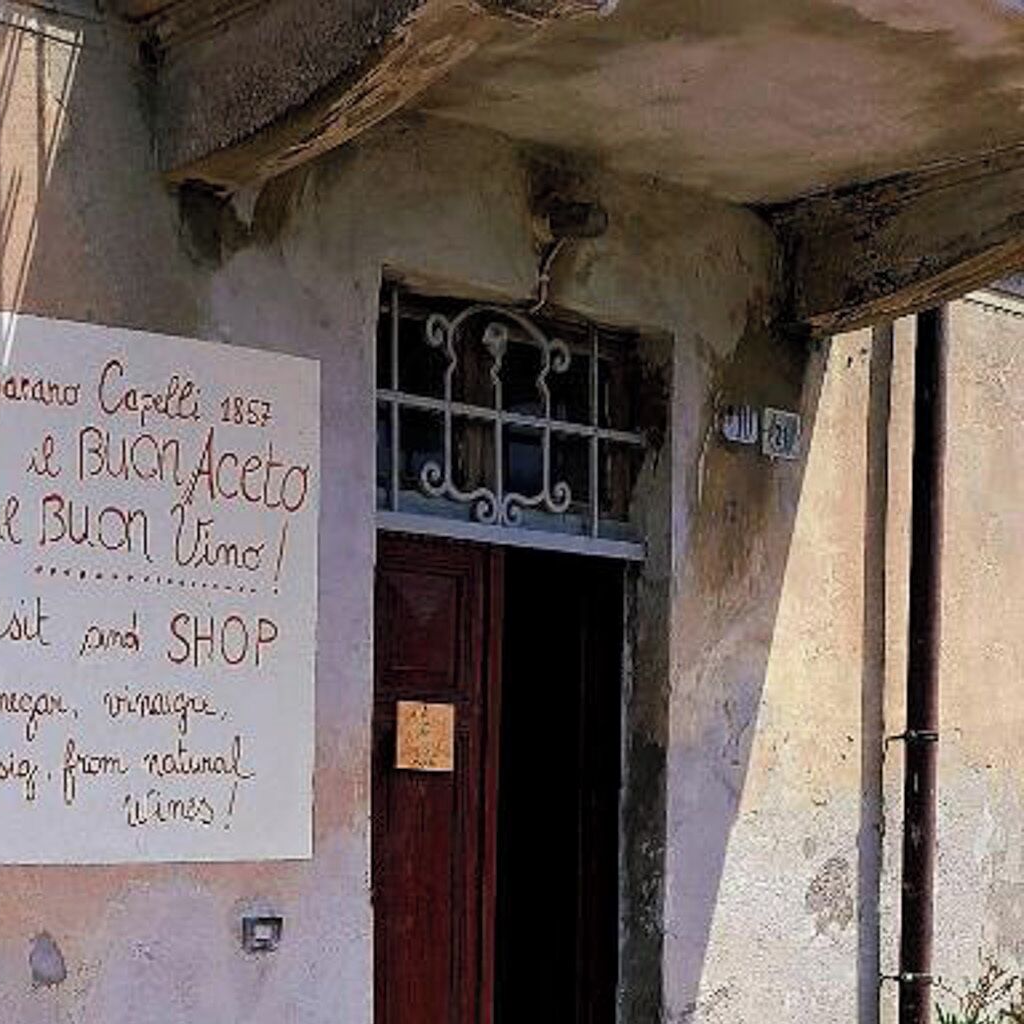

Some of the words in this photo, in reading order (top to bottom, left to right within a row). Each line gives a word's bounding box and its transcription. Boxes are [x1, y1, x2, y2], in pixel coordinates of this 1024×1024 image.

[98, 359, 202, 427] Capelli
[220, 396, 273, 427] 1857
[27, 434, 62, 479] il
[181, 426, 309, 513] Aceto
[79, 610, 140, 657] and
[167, 611, 279, 667] SHOP
[63, 738, 128, 806] from
[143, 735, 256, 780] natural
